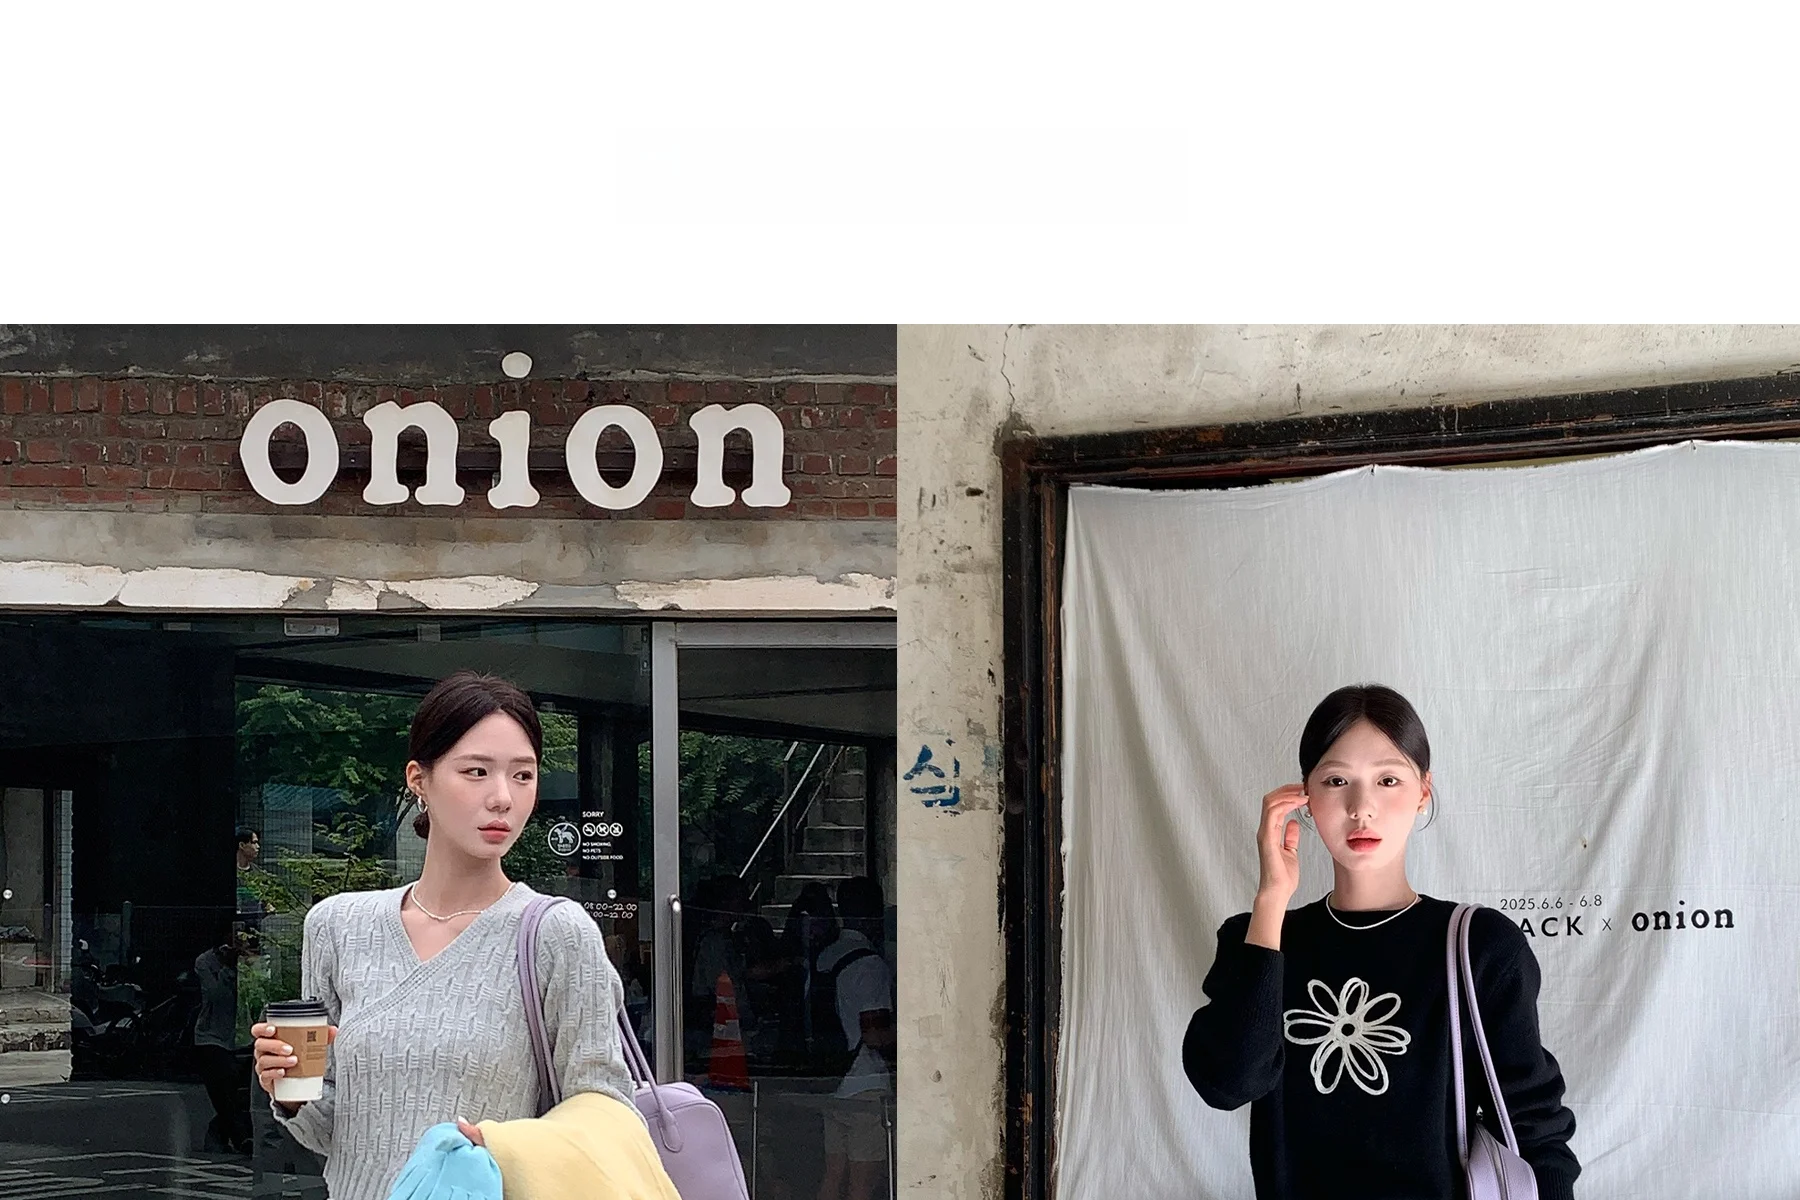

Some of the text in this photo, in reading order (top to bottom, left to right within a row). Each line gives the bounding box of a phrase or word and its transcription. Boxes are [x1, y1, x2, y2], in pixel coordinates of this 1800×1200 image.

[240, 352, 792, 509] onion
[1500, 897, 1563, 910] 2025.6.6
[1580, 894, 1602, 907] 6.8
[1520, 916, 1584, 937] ACK
[1631, 900, 1735, 932] onion
